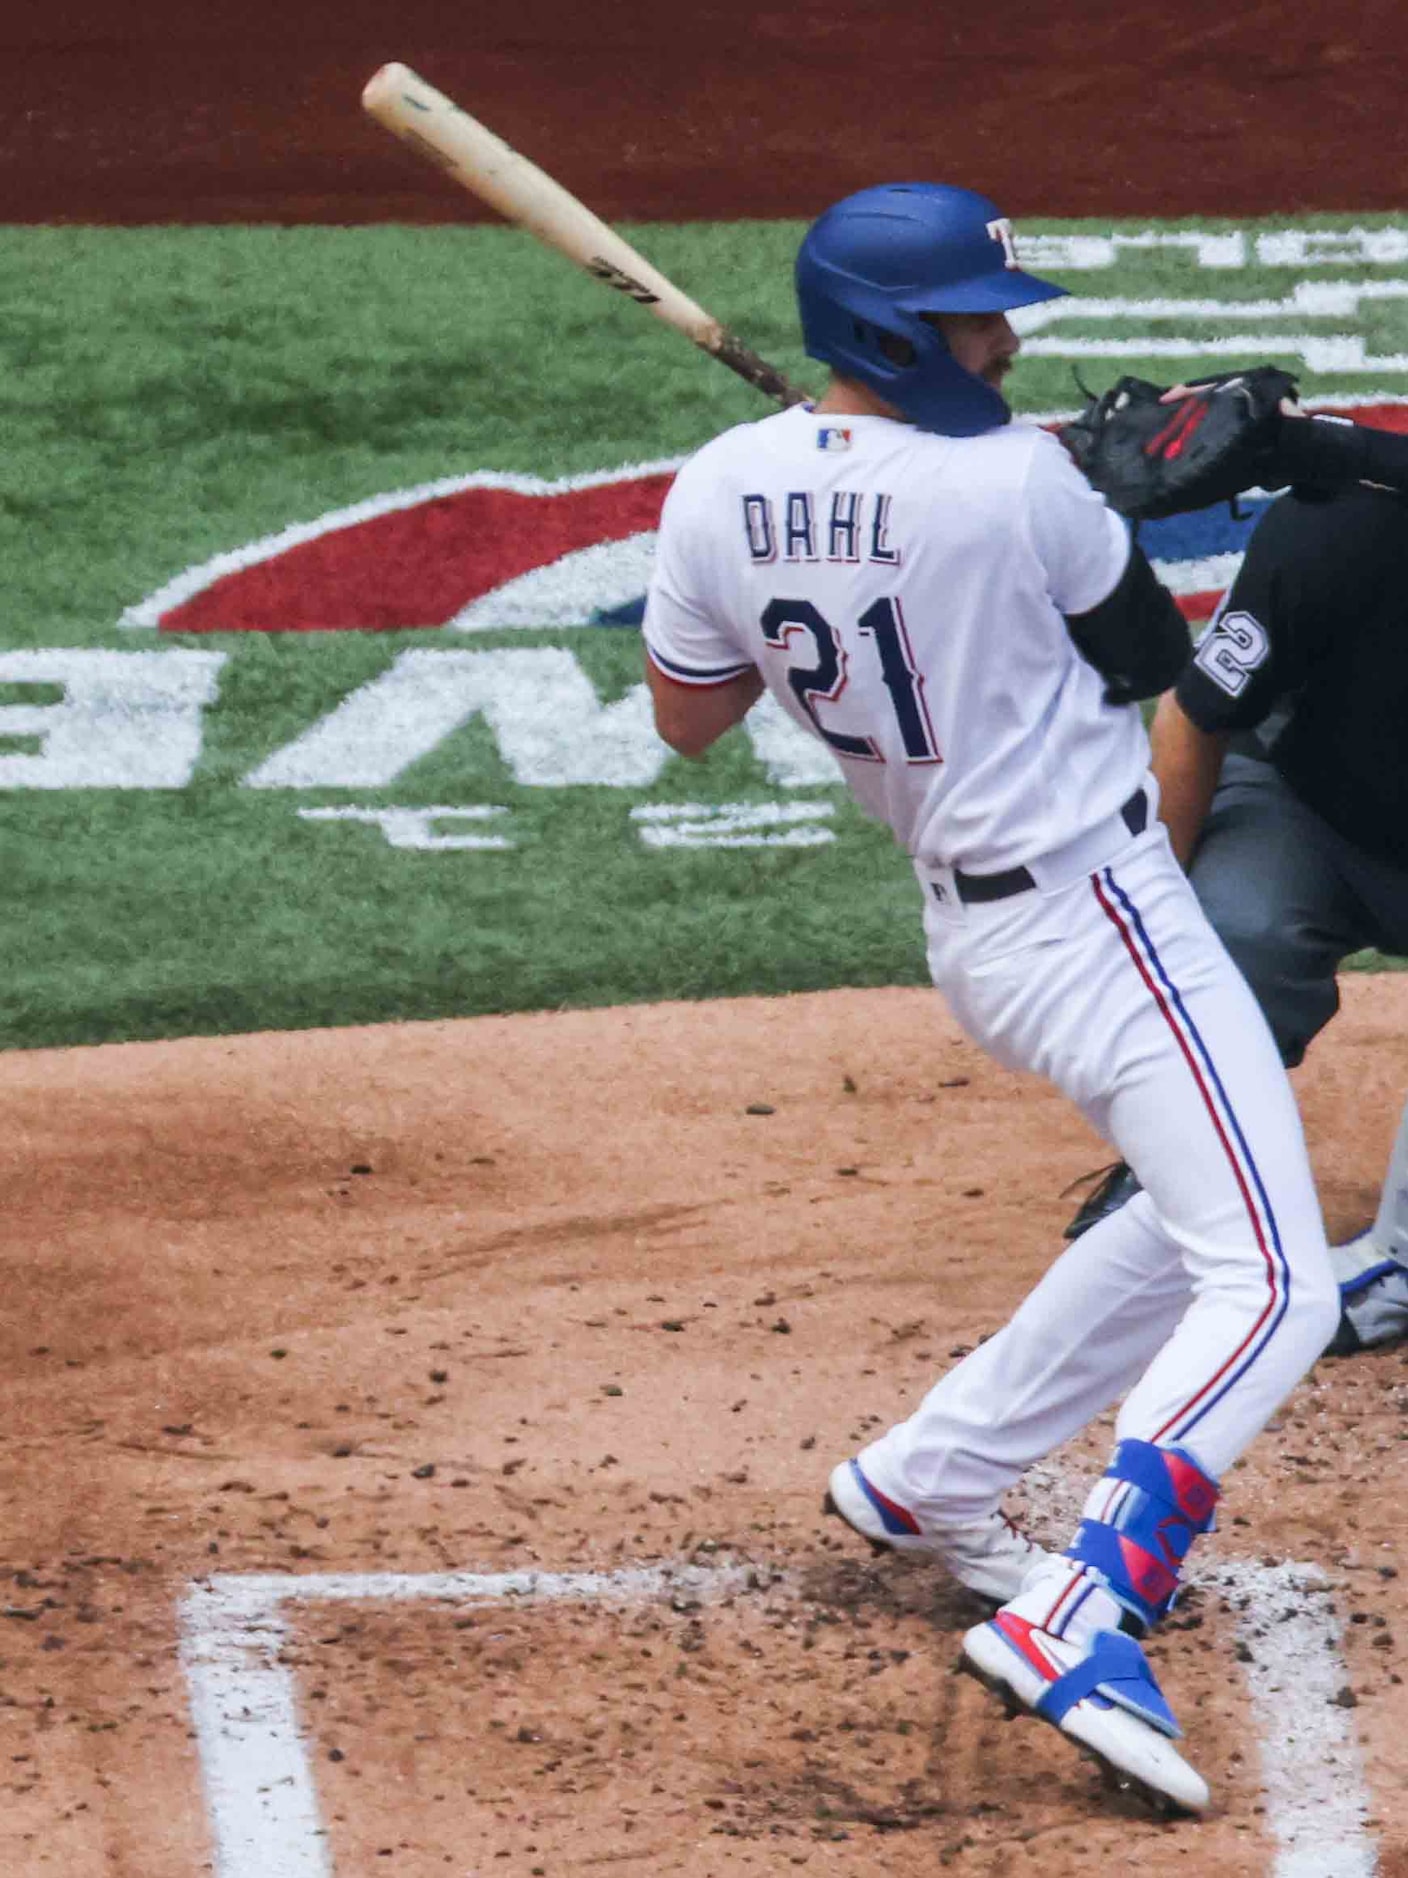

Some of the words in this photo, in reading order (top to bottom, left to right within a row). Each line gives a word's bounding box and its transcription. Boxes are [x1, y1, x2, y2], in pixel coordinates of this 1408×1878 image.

[985, 217, 1022, 272] T
[741, 491, 901, 566] DAHL
[759, 596, 944, 765] 21
